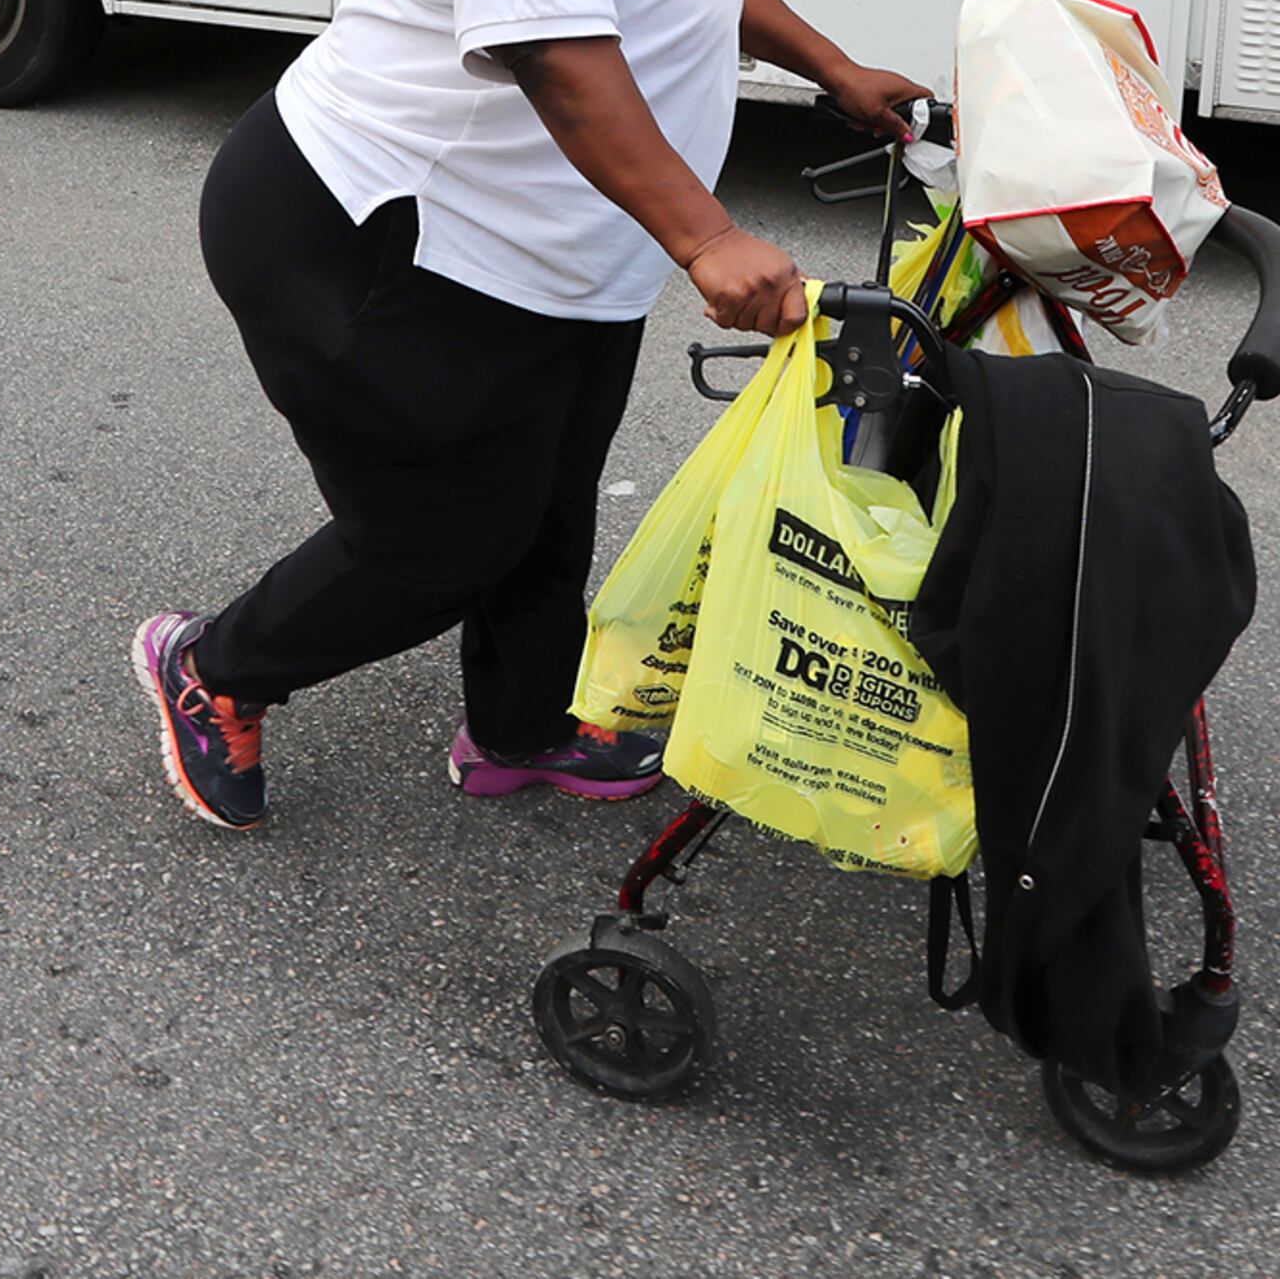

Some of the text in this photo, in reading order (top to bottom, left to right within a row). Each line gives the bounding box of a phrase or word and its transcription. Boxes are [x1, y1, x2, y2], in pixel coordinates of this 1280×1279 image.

[767, 609, 807, 639] Save
[807, 631, 849, 658] over
[775, 635, 831, 693] DG
